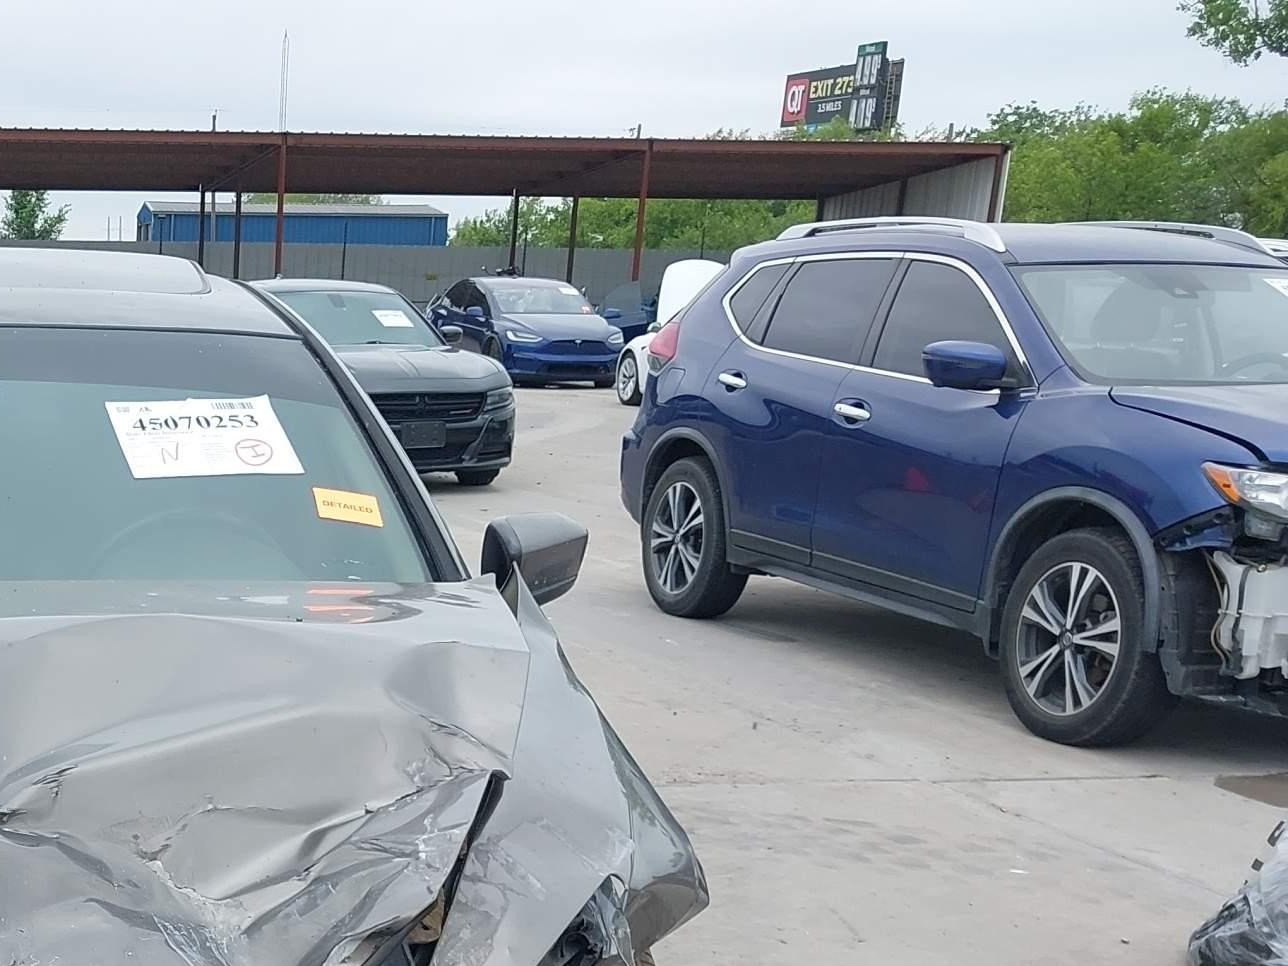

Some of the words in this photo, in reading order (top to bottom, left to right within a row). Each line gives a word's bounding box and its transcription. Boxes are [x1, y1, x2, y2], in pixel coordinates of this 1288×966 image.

[809, 79, 834, 98] EXIT
[834, 75, 854, 95] 273
[787, 85, 806, 114] QT
[826, 101, 842, 112] MILES
[132, 414, 259, 432] 45070253
[322, 500, 373, 514] DETAILED
